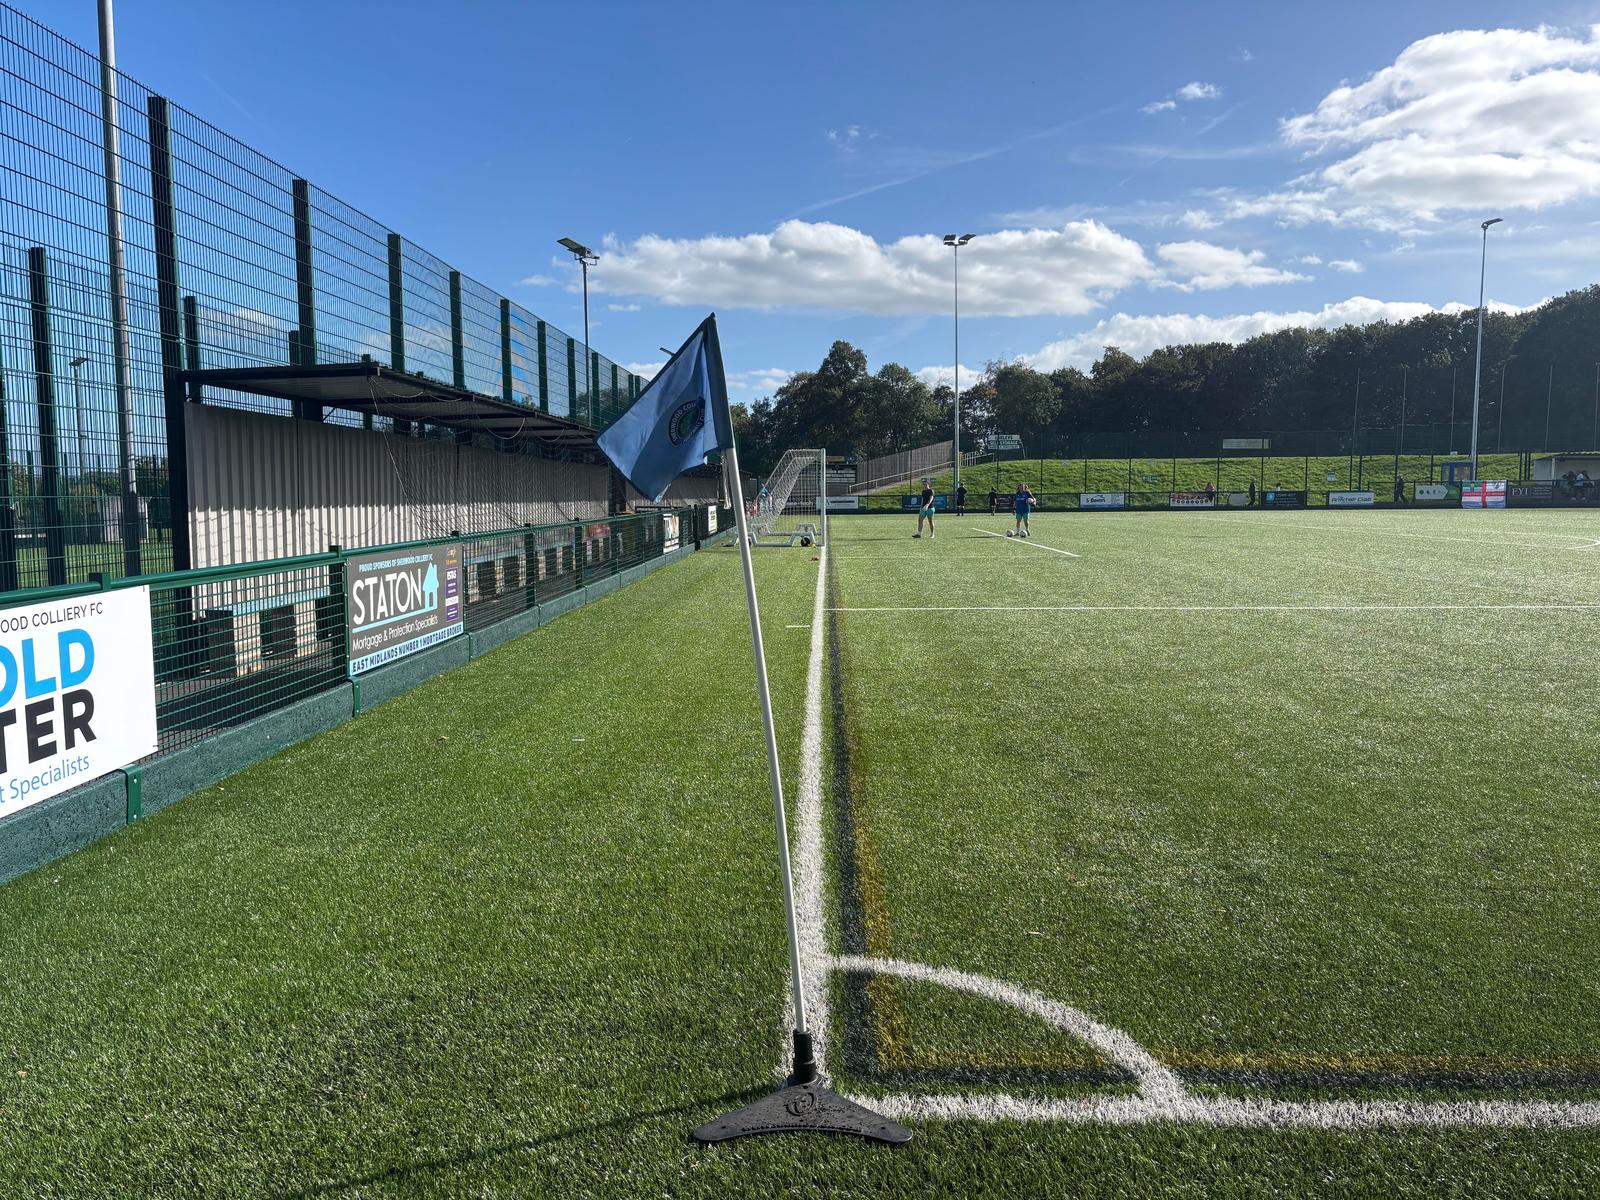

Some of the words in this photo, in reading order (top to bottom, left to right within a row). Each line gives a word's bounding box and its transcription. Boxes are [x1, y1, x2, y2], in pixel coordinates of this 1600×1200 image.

[32, 603, 87, 626] COLLIERY
[90, 602, 104, 615] FC
[352, 568, 422, 625] STATON
[352, 634, 383, 652] Mortgage
[383, 630, 388, 641] &
[388, 621, 415, 640] Protection
[415, 614, 438, 632] Specialists
[352, 659, 369, 672] EAST
[370, 648, 398, 666] MIDLANDS
[398, 641, 420, 655] NUMBER
[422, 630, 446, 648] MORTGAGE
[446, 624, 462, 639] BROKER
[10, 754, 90, 801] Specialists
